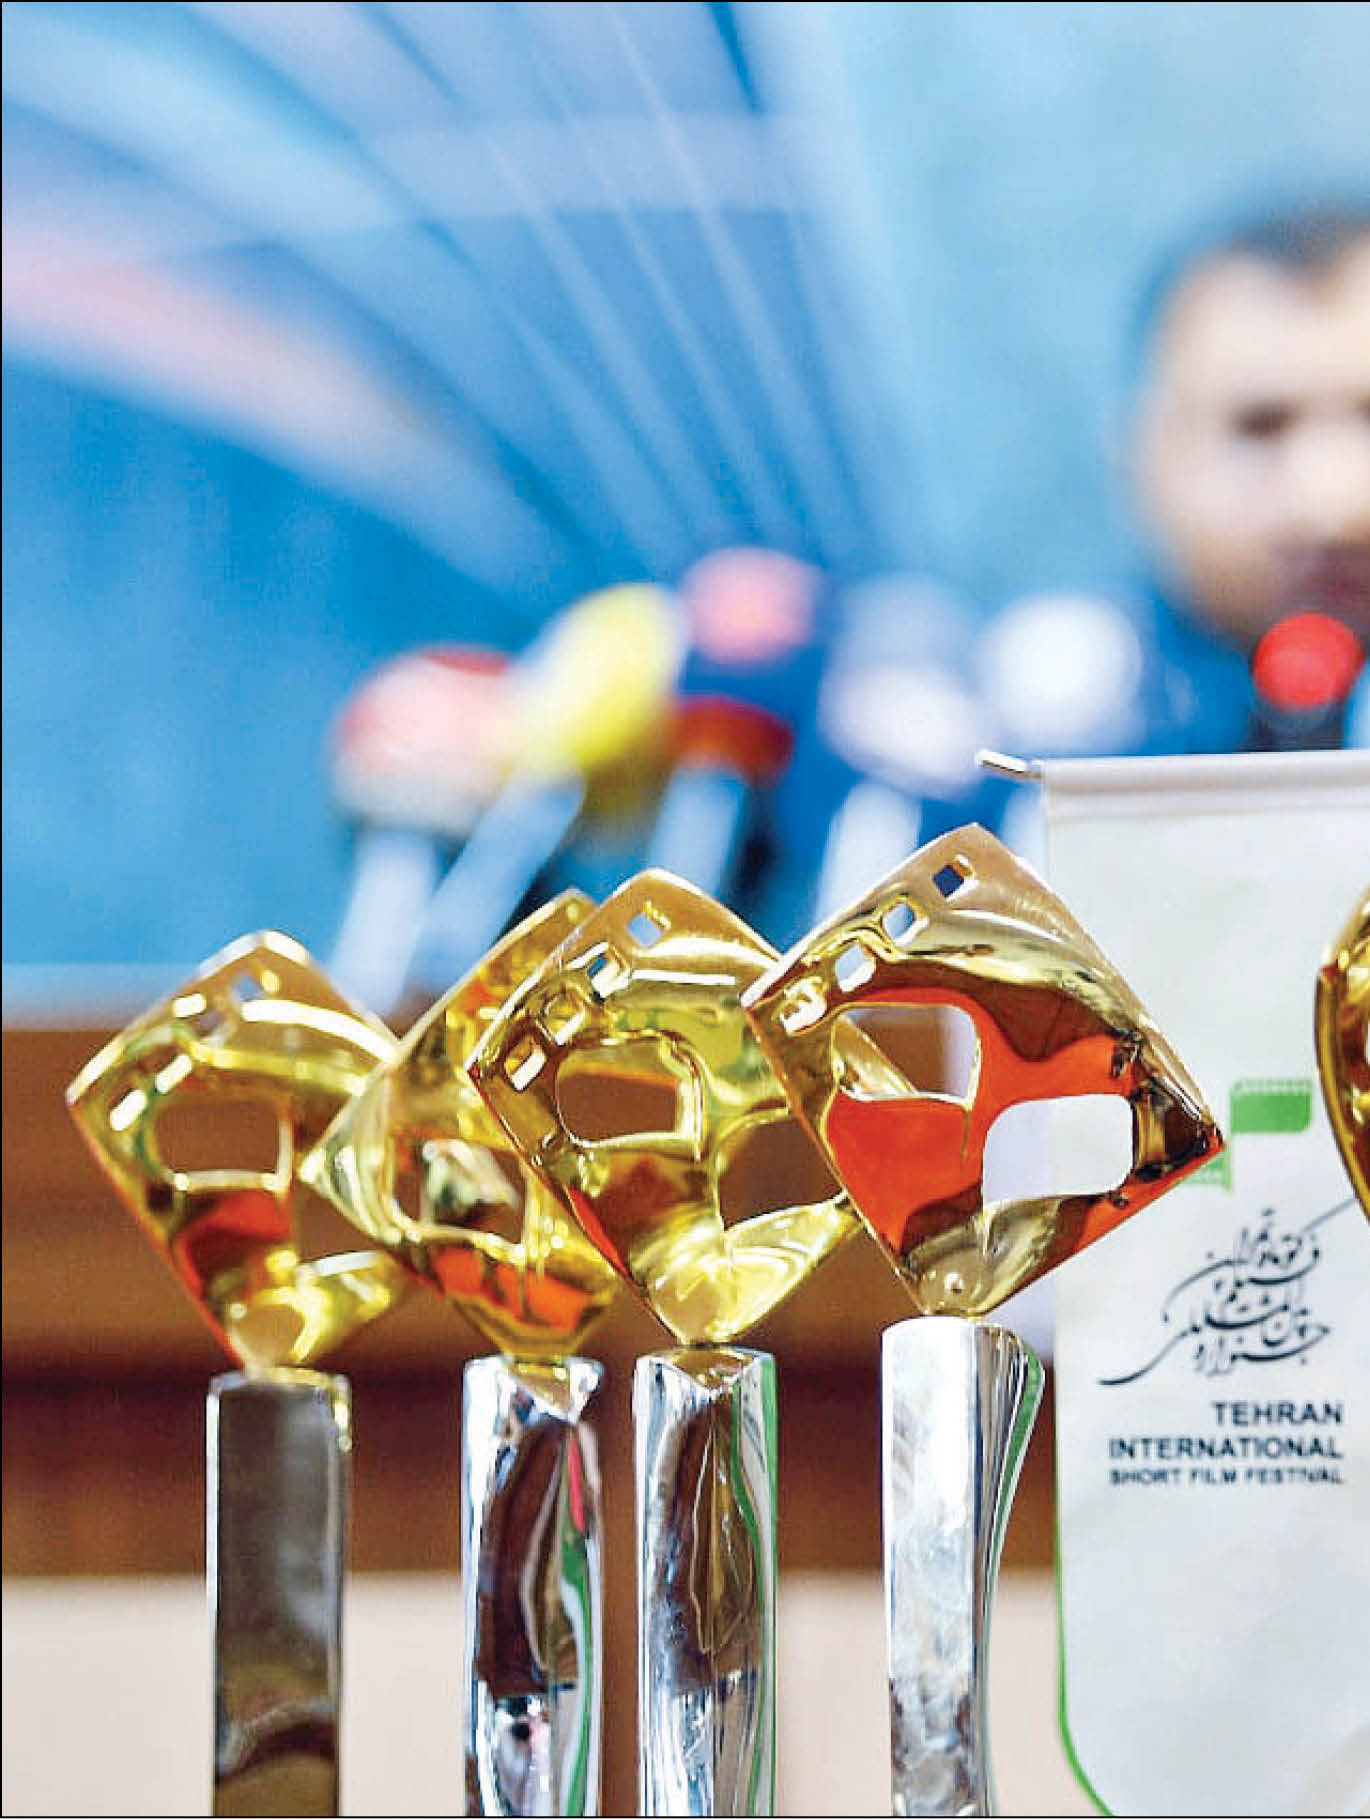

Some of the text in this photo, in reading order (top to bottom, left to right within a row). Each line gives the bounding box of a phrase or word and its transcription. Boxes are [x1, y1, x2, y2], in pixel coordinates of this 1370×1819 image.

[1211, 1401, 1344, 1427] TEHRAN
[1109, 1437, 1345, 1459] INTERNATIONAL
[1110, 1467, 1345, 1485] SHORT FILM FESTIVAL
